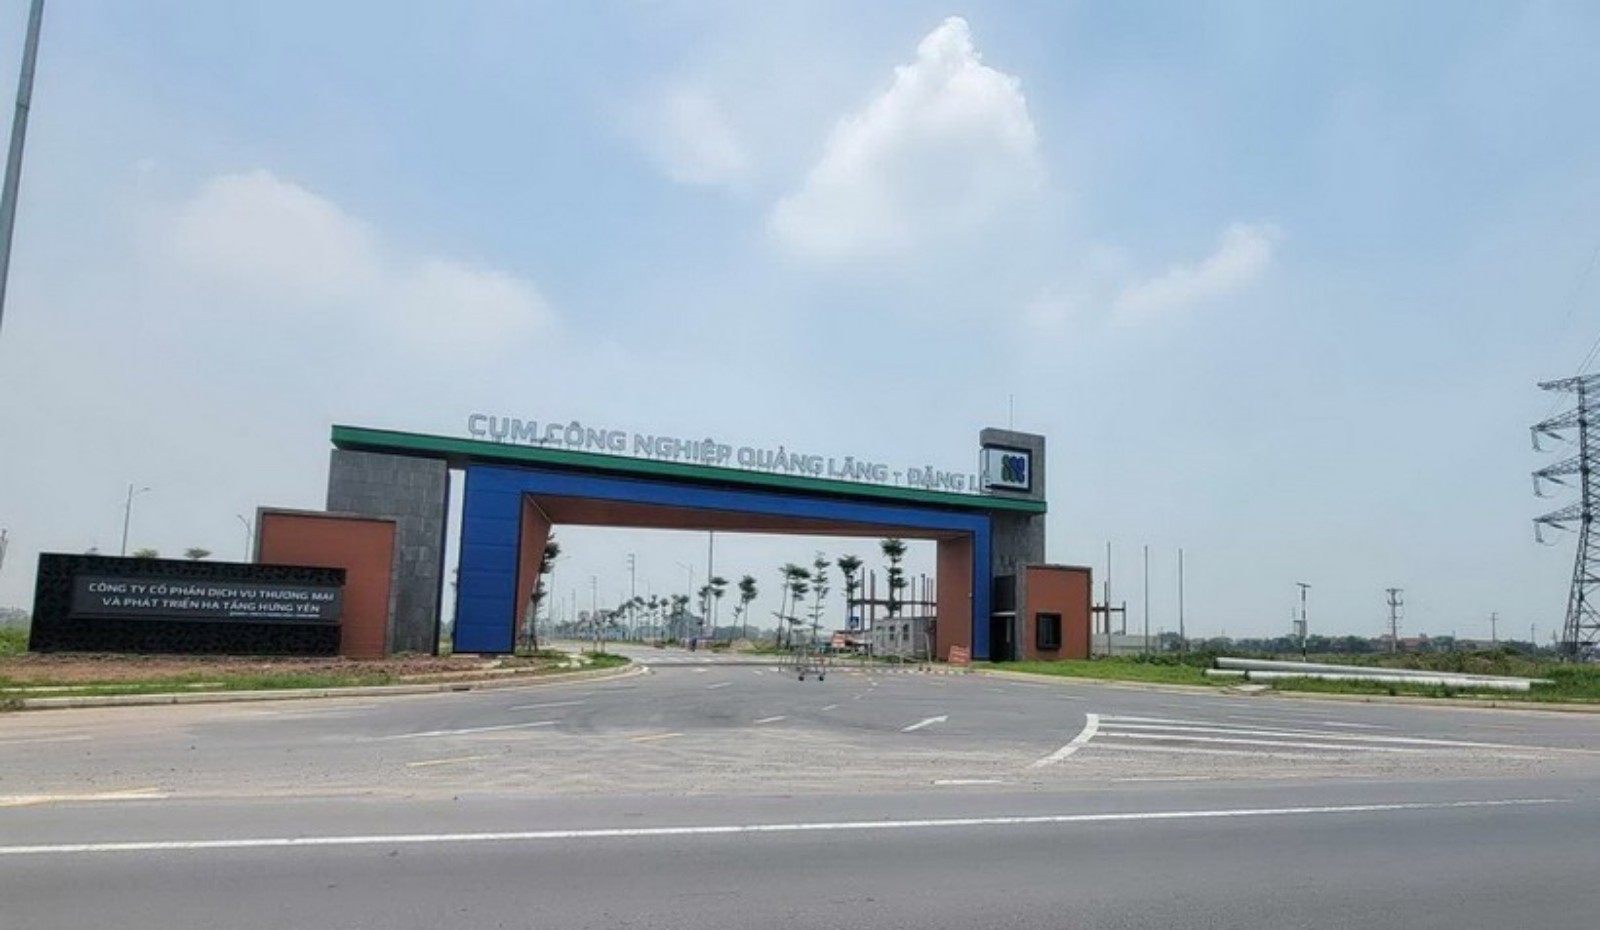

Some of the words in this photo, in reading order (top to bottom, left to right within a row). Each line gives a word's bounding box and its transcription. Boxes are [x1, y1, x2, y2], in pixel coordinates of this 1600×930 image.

[545, 421, 627, 451] CÔNG
[89, 582, 127, 594] CÔNG
[130, 585, 147, 594] TY
